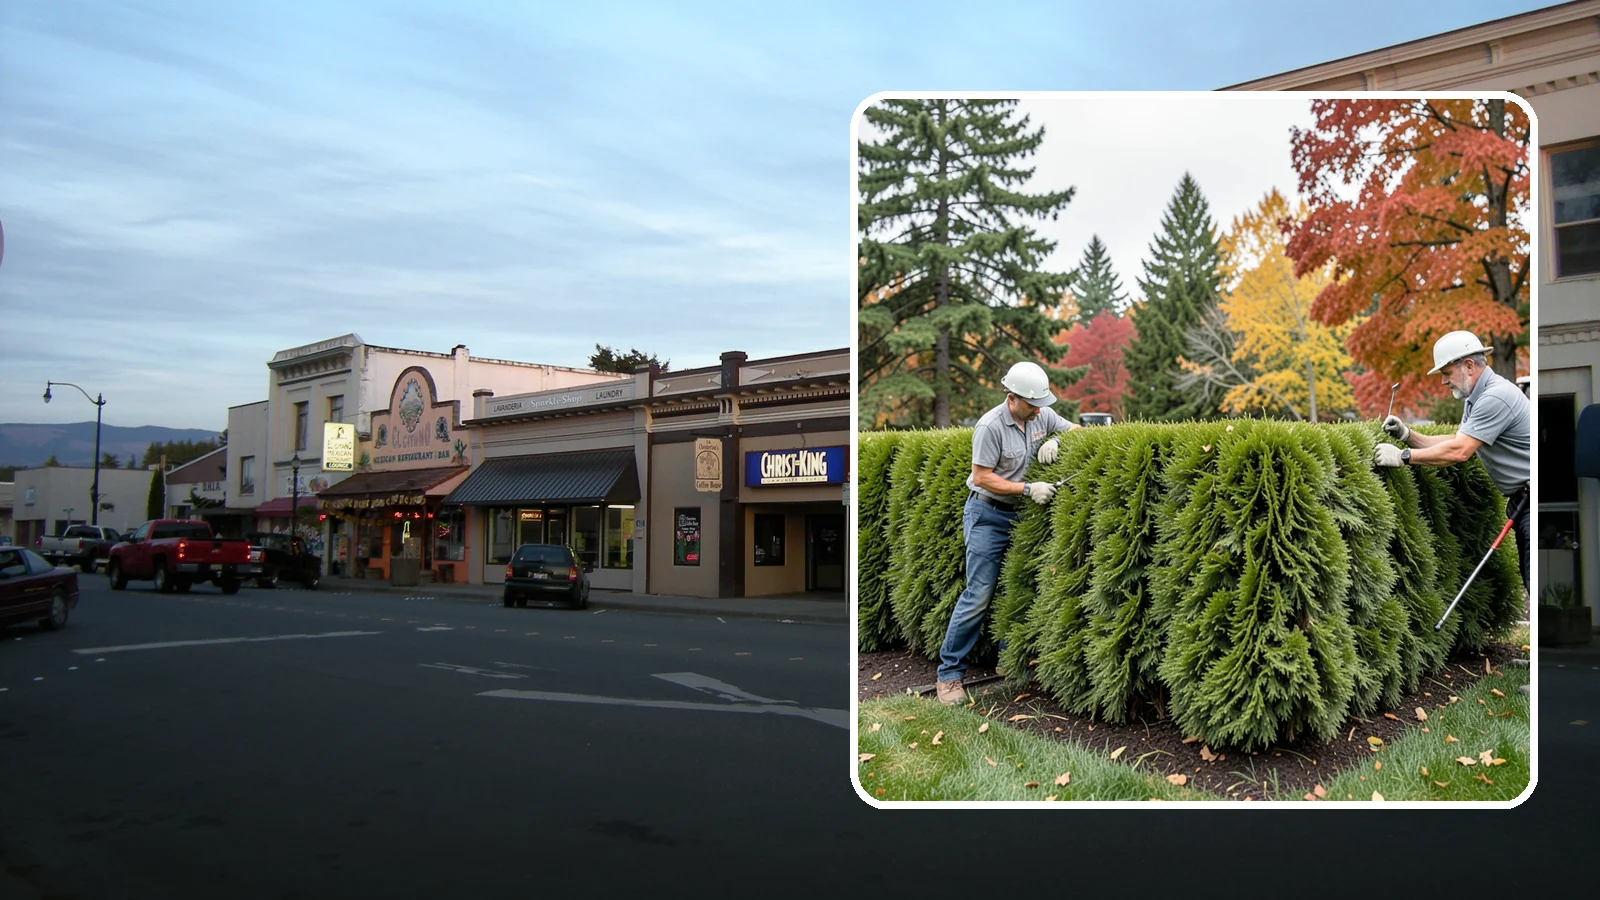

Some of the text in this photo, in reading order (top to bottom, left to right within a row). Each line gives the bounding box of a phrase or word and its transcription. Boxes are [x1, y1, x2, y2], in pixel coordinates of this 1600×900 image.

[530, 394, 582, 409] Sparkle Shop
[596, 389, 623, 400] LAUNDRY
[493, 402, 522, 412] LAVANDERIA
[373, 454, 396, 464] MEXICAN
[397, 451, 433, 462] RESTAURANT
[438, 450, 450, 459] BAR
[761, 450, 827, 477] CHRIST KING
